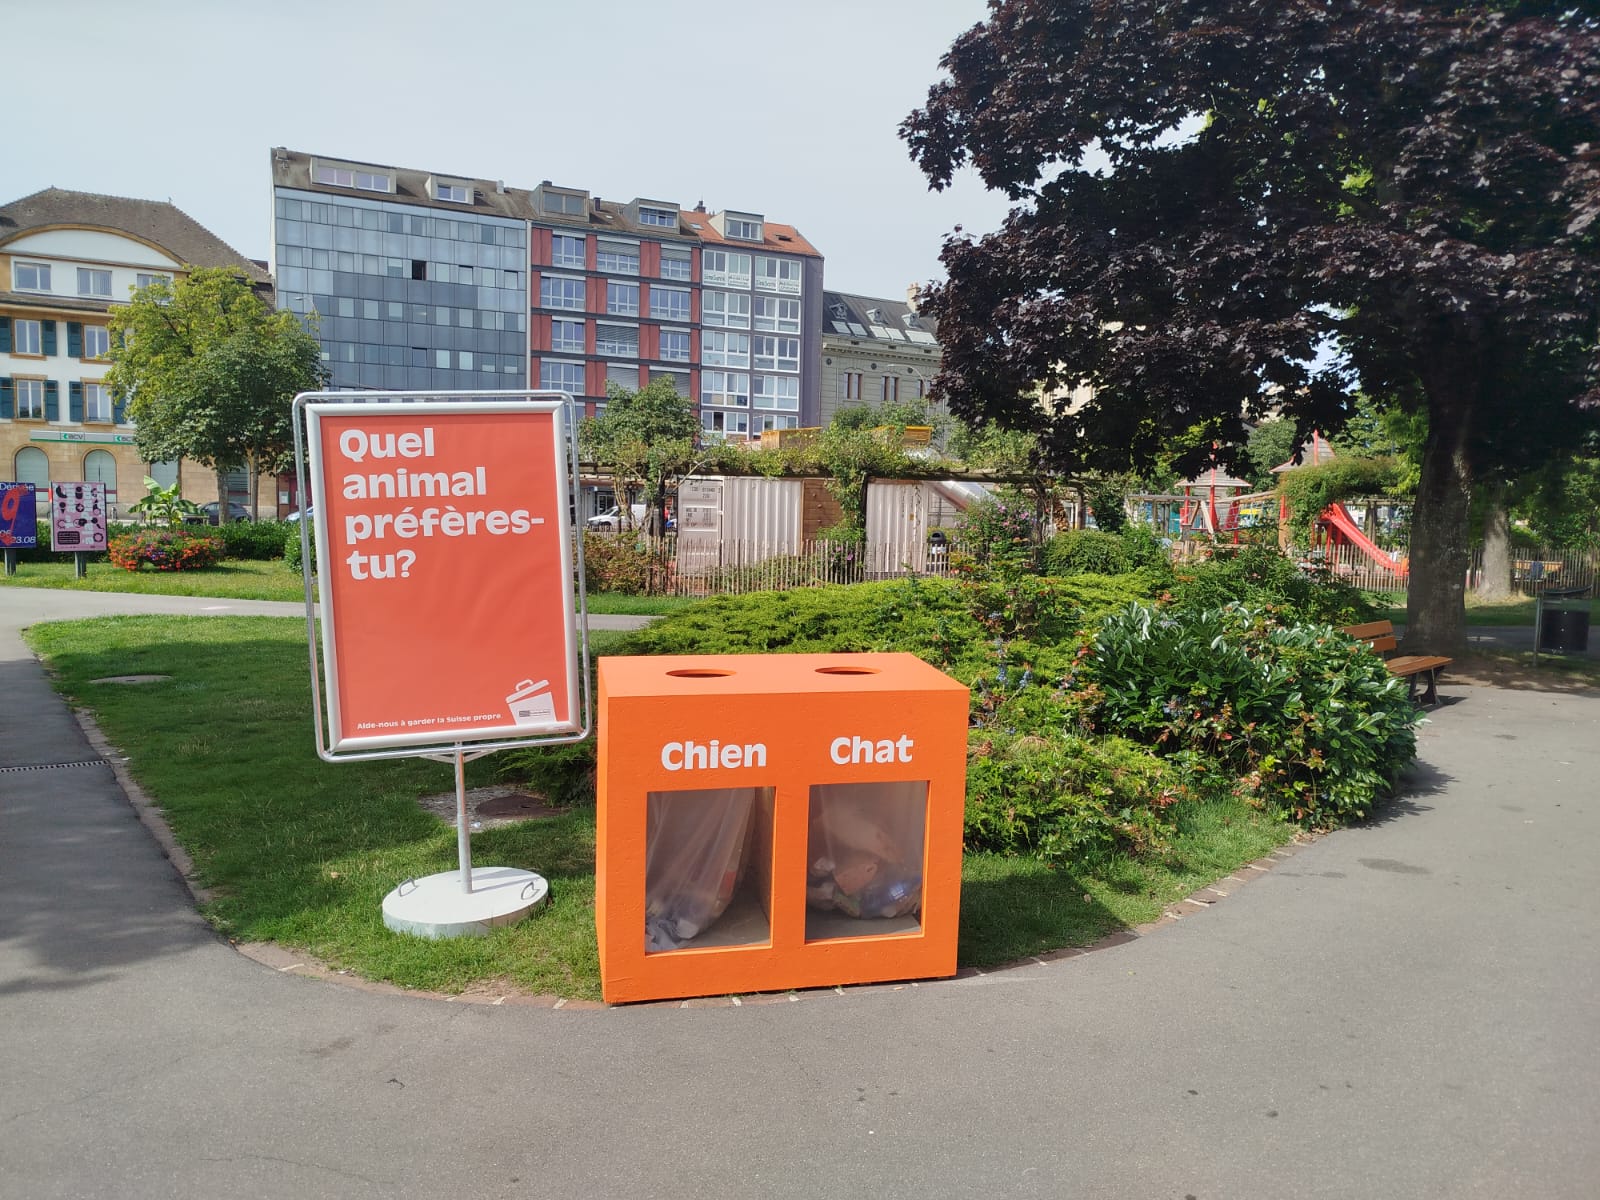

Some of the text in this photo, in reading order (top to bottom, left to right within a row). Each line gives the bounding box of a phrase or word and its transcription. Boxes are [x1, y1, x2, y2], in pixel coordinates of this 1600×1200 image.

[339, 427, 435, 462] Quel
[343, 466, 487, 500] animal
[345, 505, 545, 545] préfères-
[346, 549, 417, 581] tu?
[357, 721, 399, 730] Aide-nous
[407, 717, 436, 727] garder
[437, 716, 445, 724] la
[446, 714, 472, 723] Suisse
[661, 740, 767, 771] Chien
[830, 734, 914, 765] Chat
